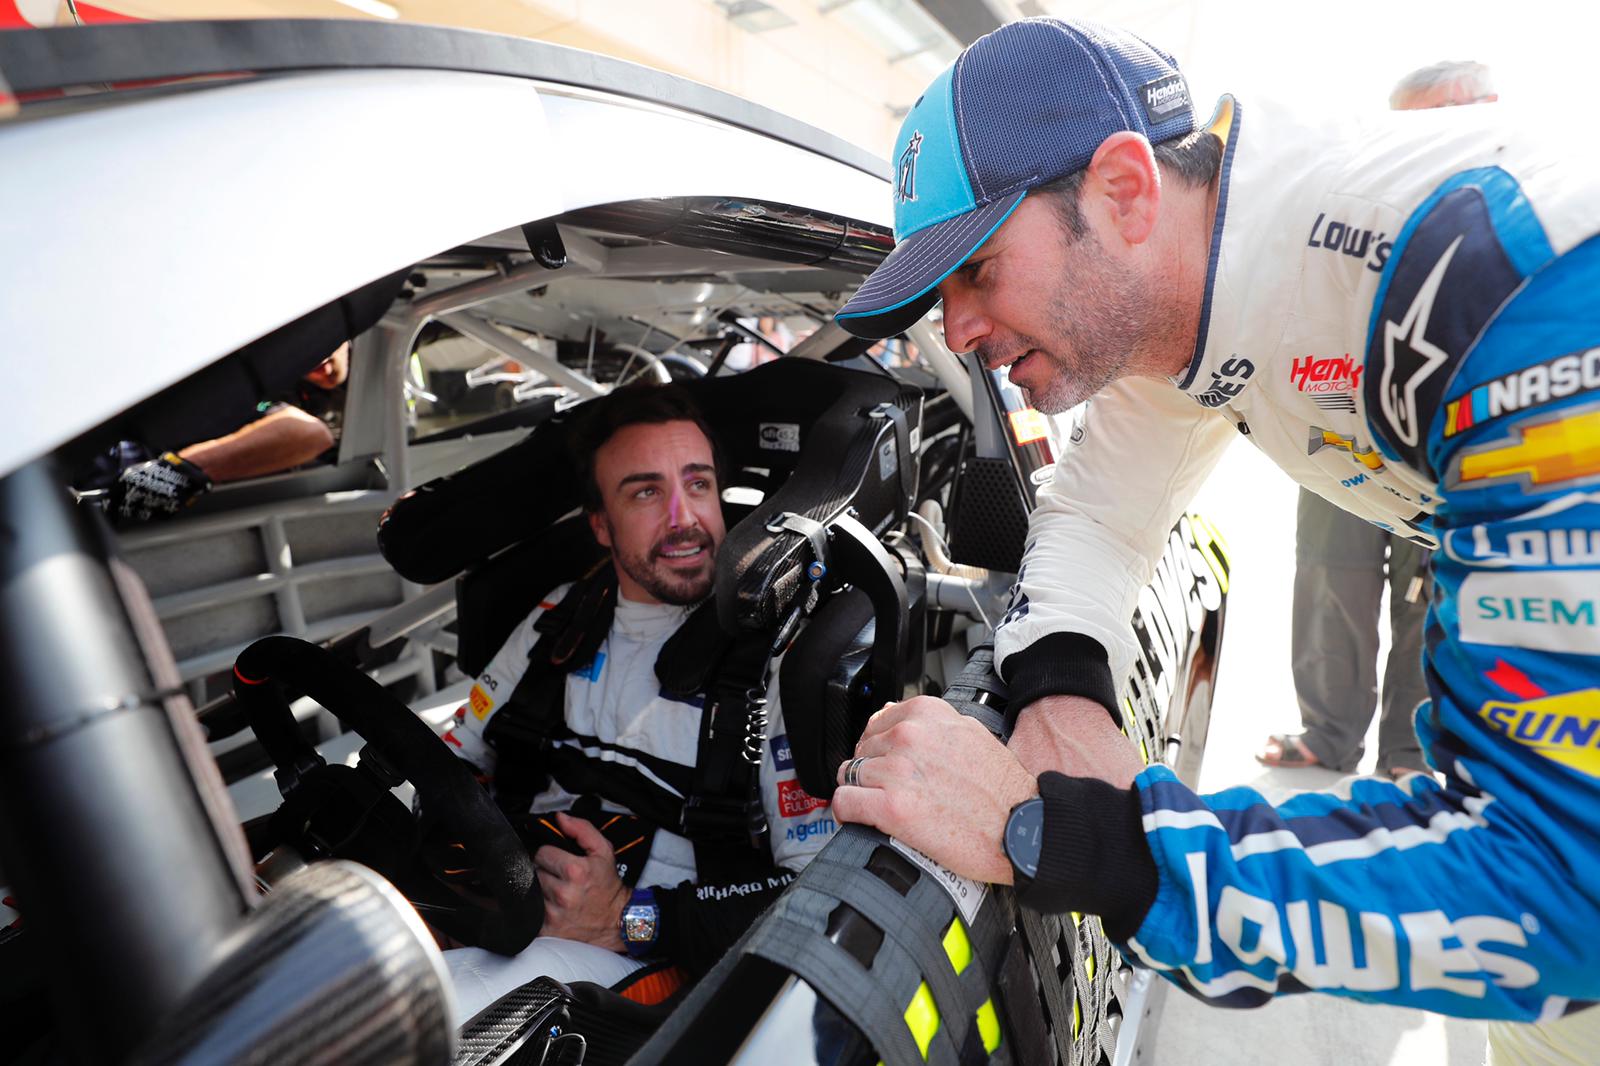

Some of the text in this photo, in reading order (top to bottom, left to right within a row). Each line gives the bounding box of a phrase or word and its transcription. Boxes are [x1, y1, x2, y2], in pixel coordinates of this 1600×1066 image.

[1488, 347, 1600, 417] NASC
[1477, 595, 1595, 626] SIEM
[696, 883, 763, 900] RICHARD
